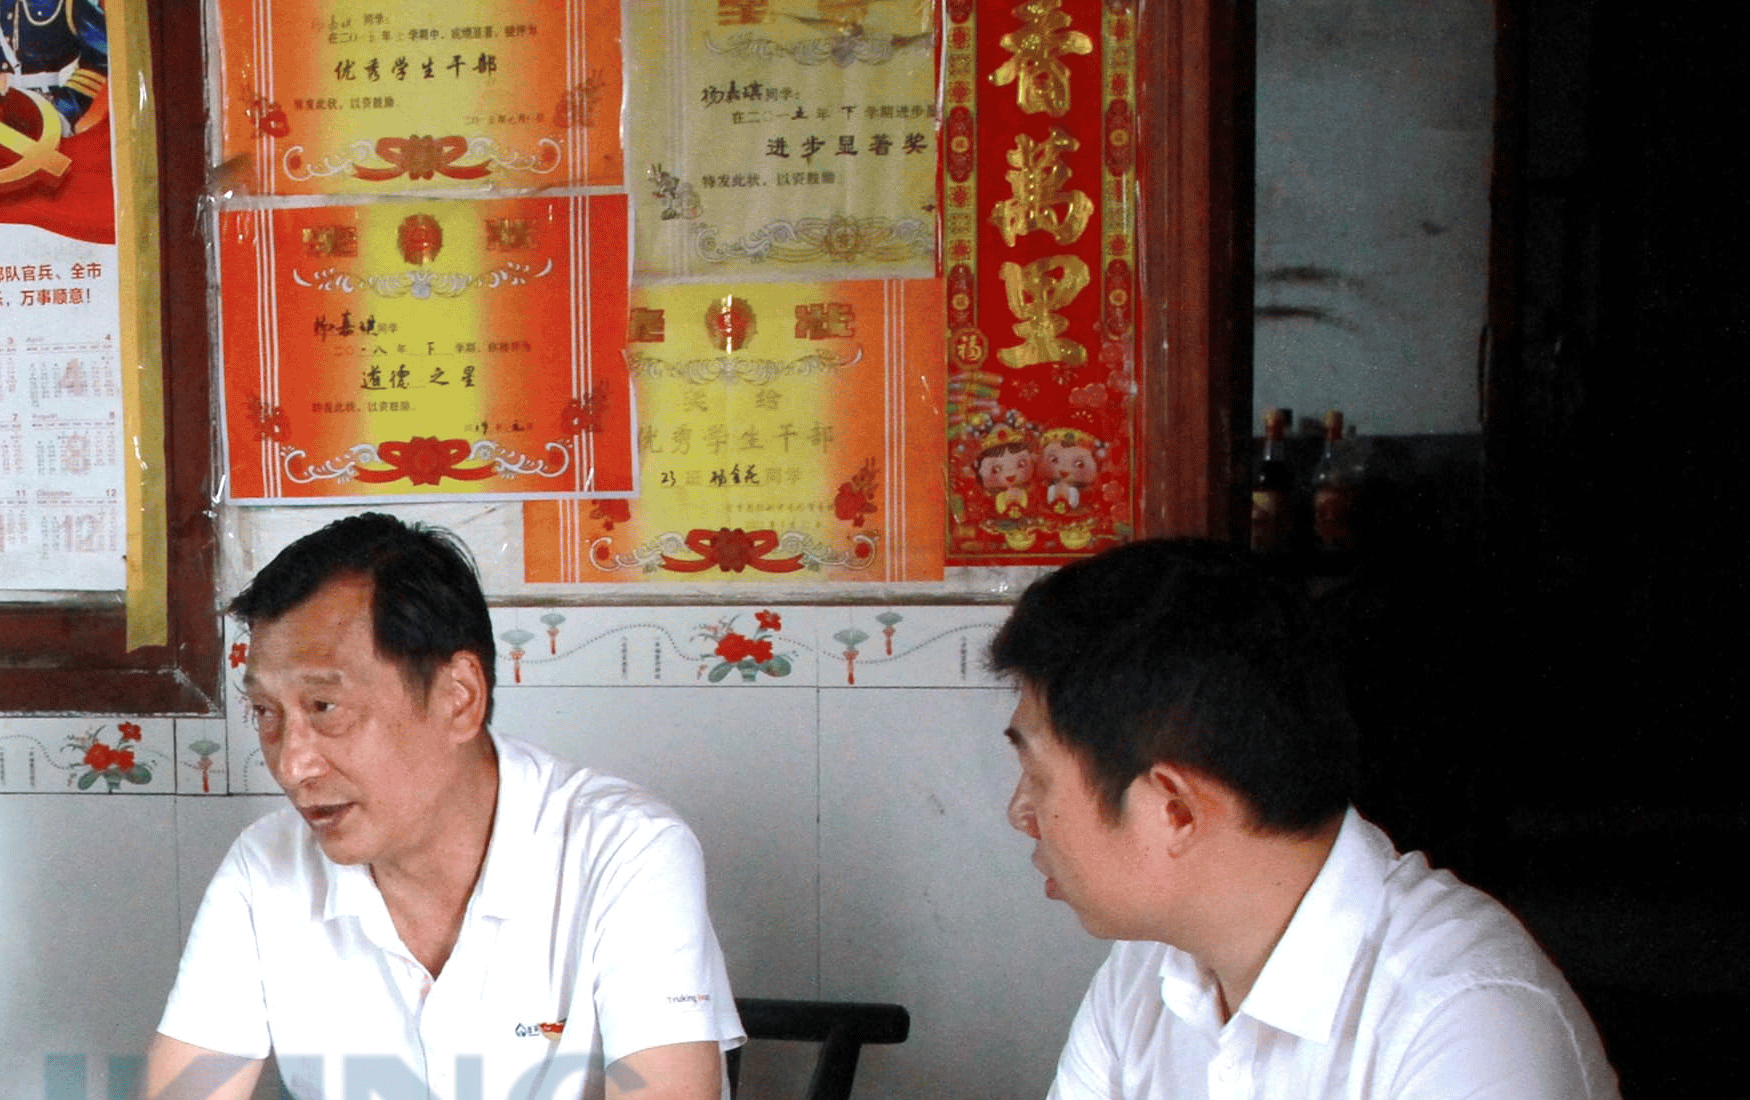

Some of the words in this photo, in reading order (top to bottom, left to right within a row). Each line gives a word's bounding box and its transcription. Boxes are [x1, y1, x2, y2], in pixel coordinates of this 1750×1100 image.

[334, 51, 498, 82] 优秀学生干部
[765, 132, 928, 159] 进步显著奖
[359, 363, 476, 390] 道德之星
